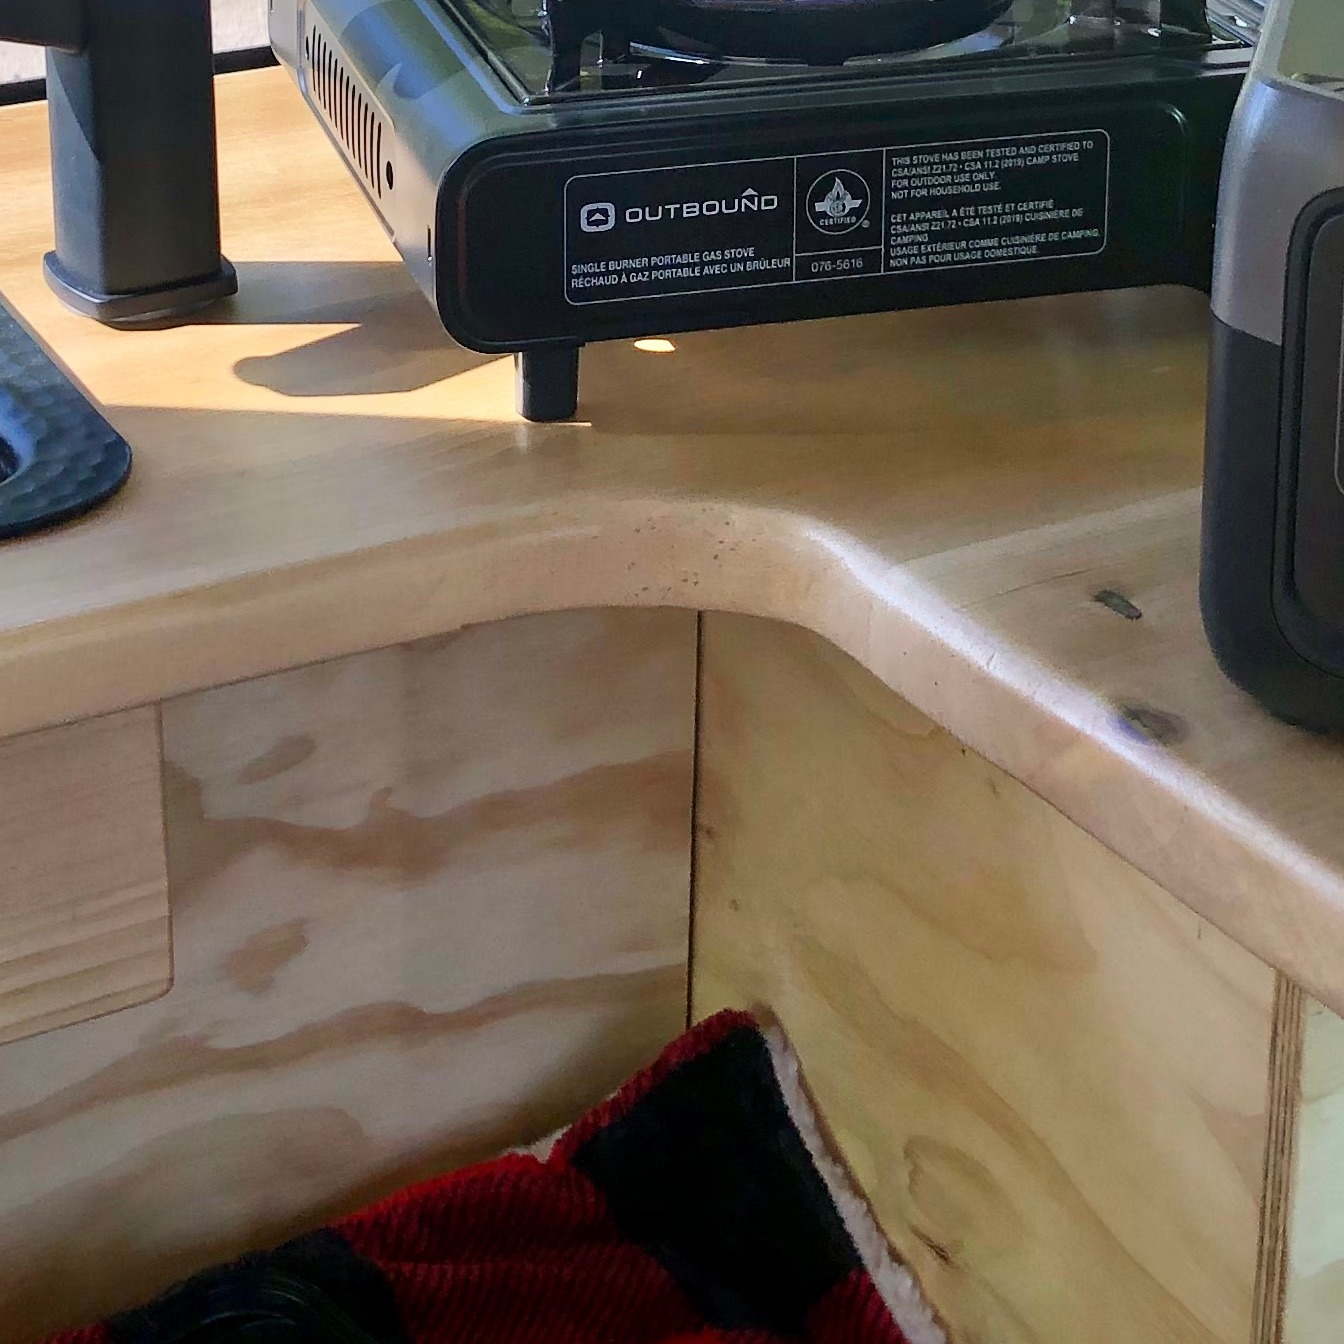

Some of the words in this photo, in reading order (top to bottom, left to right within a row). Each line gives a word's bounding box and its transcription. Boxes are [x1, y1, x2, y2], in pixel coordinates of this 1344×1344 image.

[913, 154, 939, 164] STOVE
[942, 152, 959, 161] HAS
[961, 150, 983, 160] BEEN
[985, 148, 1016, 158] TESTED
[1019, 146, 1036, 155] AND
[1038, 142, 1079, 153] CERTIFIED
[1082, 141, 1093, 149] TO
[965, 161, 981, 171] CSA
[984, 159, 999, 169] 11.2
[1027, 156, 1049, 165] CAMP
[1052, 153, 1079, 163] STOVE
[892, 179, 908, 188] FOR
[911, 175, 951, 187] OUTDOOR
[954, 173, 970, 183] USE
[892, 190, 908, 199] NOT
[911, 188, 928, 197] FOR
[930, 184, 980, 196] HOUSEHOLD
[626, 194, 777, 222] OUTBOUND
[891, 214, 906, 223] CET
[909, 210, 948, 221] APPAREIL
[952, 209, 957, 217] A
[978, 204, 1003, 215] TESTÉ
[1005, 203, 1015, 211] ET
[820, 216, 856, 225] CERTIFIED
[963, 218, 980, 227] CSA
[982, 216, 998, 226] 11.2
[1072, 208, 1083, 217] DE
[890, 245, 918, 256] USAGE
[921, 240, 966, 253] EXTÉRIEUR
[969, 238, 999, 249] COMME
[1048, 232, 1058, 241] DE
[891, 234, 928, 244] CAMPING
[572, 262, 606, 274] SINGLE
[609, 258, 648, 270] BURNER
[651, 253, 700, 266] PORTABLE
[702, 251, 722, 261] GAS
[725, 247, 755, 257] STOVE
[811, 258, 863, 272] 076-5616
[890, 258, 907, 267] NON
[910, 255, 927, 265] PAS
[929, 253, 951, 263] POUR
[954, 251, 981, 261] USAGE
[572, 272, 618, 288] RÉCHAUD
[620, 271, 628, 282] À
[630, 271, 649, 281] GAZ
[652, 266, 700, 279] PORTABLE
[703, 264, 727, 274] AVEC
[730, 263, 744, 272] UN
[746, 257, 790, 271] BRÛLEUR
